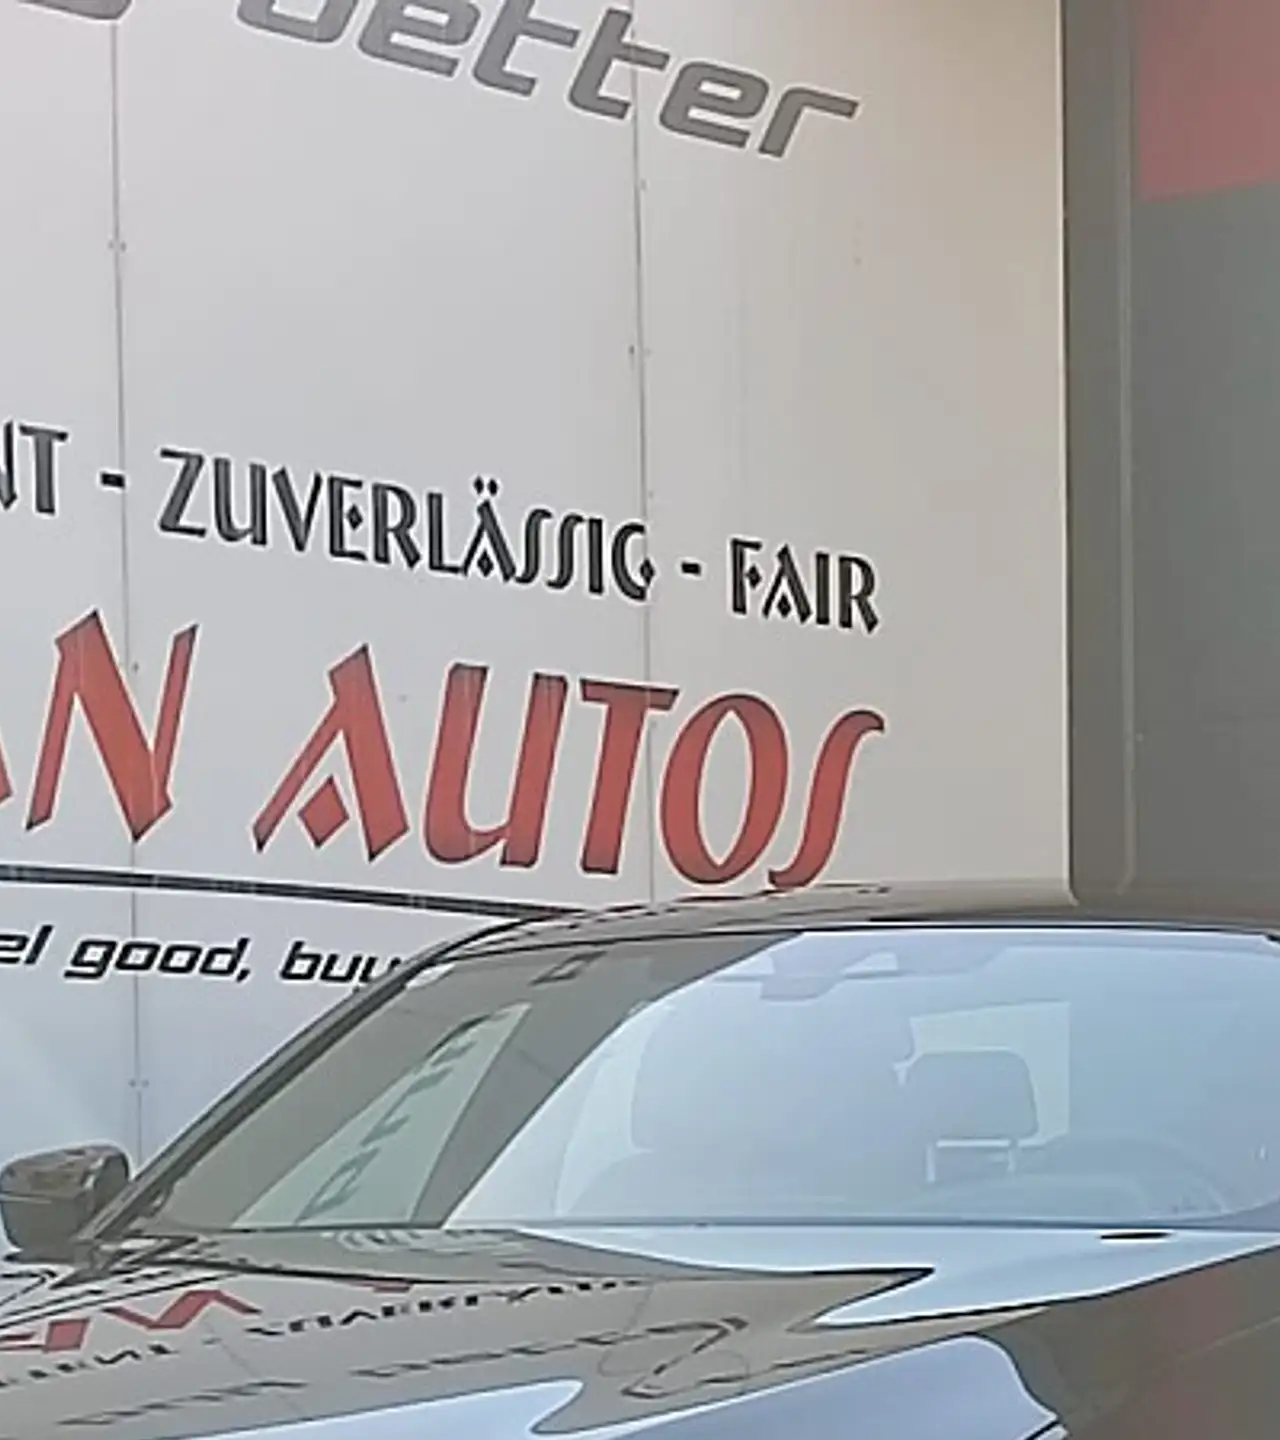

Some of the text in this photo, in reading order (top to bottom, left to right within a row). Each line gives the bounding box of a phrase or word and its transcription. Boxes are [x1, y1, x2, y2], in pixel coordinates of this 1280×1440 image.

[158, 448, 657, 601] ZUVERLÄSSIG
[731, 539, 880, 632] FAIR
[252, 644, 885, 888] AUTOS
[64, 936, 251, 981] good,
